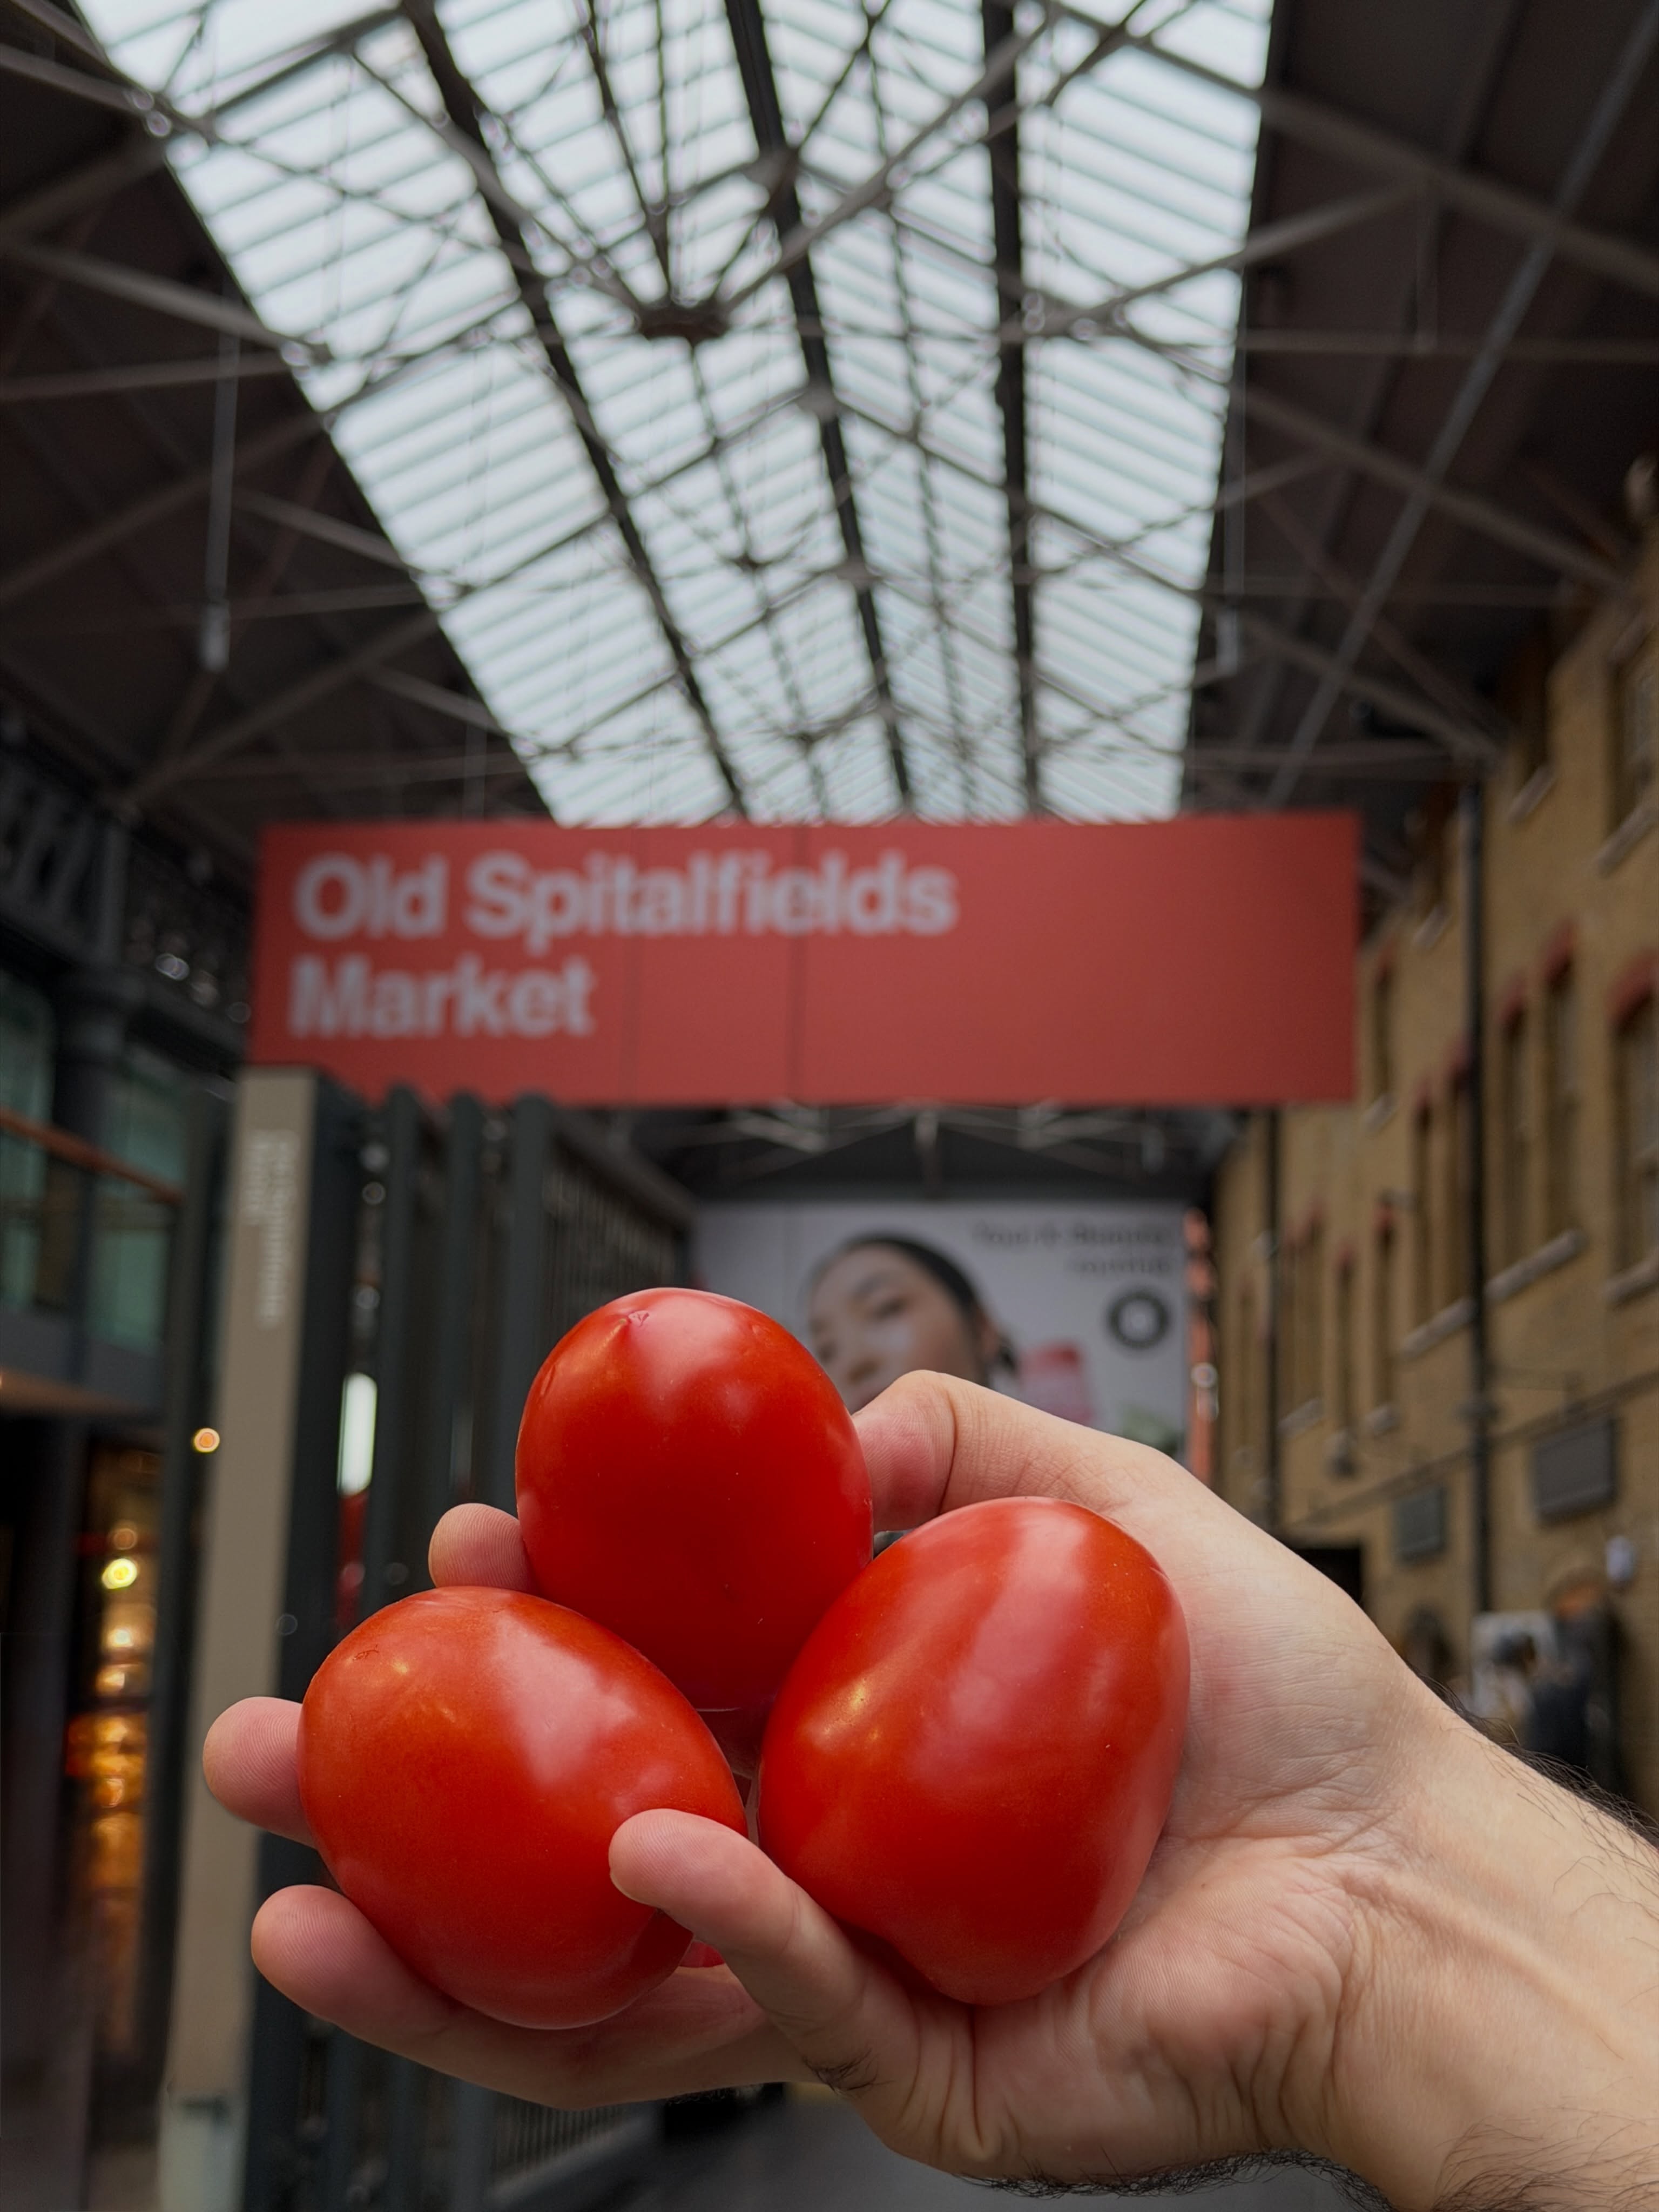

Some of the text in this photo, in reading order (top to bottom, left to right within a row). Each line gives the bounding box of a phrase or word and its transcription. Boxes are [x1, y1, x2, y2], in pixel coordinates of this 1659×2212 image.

[295, 850, 958, 956] Old Spitalfields
[289, 955, 594, 1037] Market
